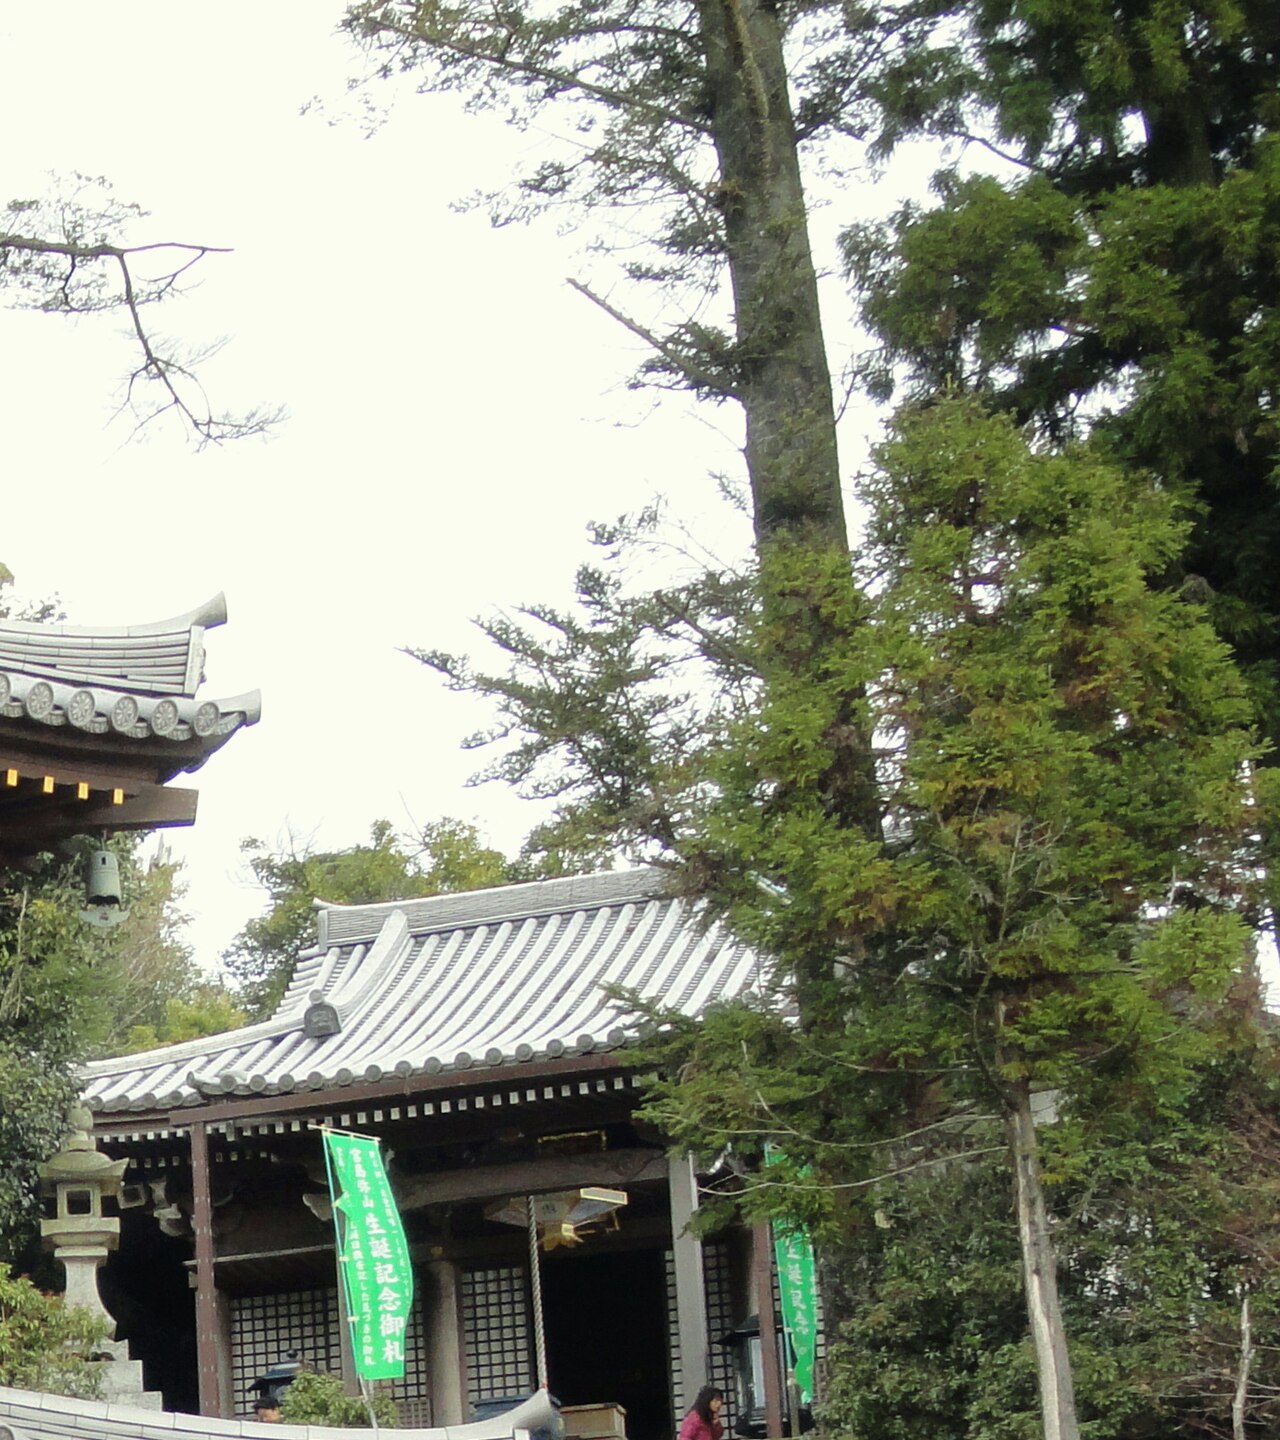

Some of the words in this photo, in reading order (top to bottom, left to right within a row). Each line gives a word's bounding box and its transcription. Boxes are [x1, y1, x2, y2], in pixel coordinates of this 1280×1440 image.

[364, 1212, 405, 1363] 生誕記念御札
